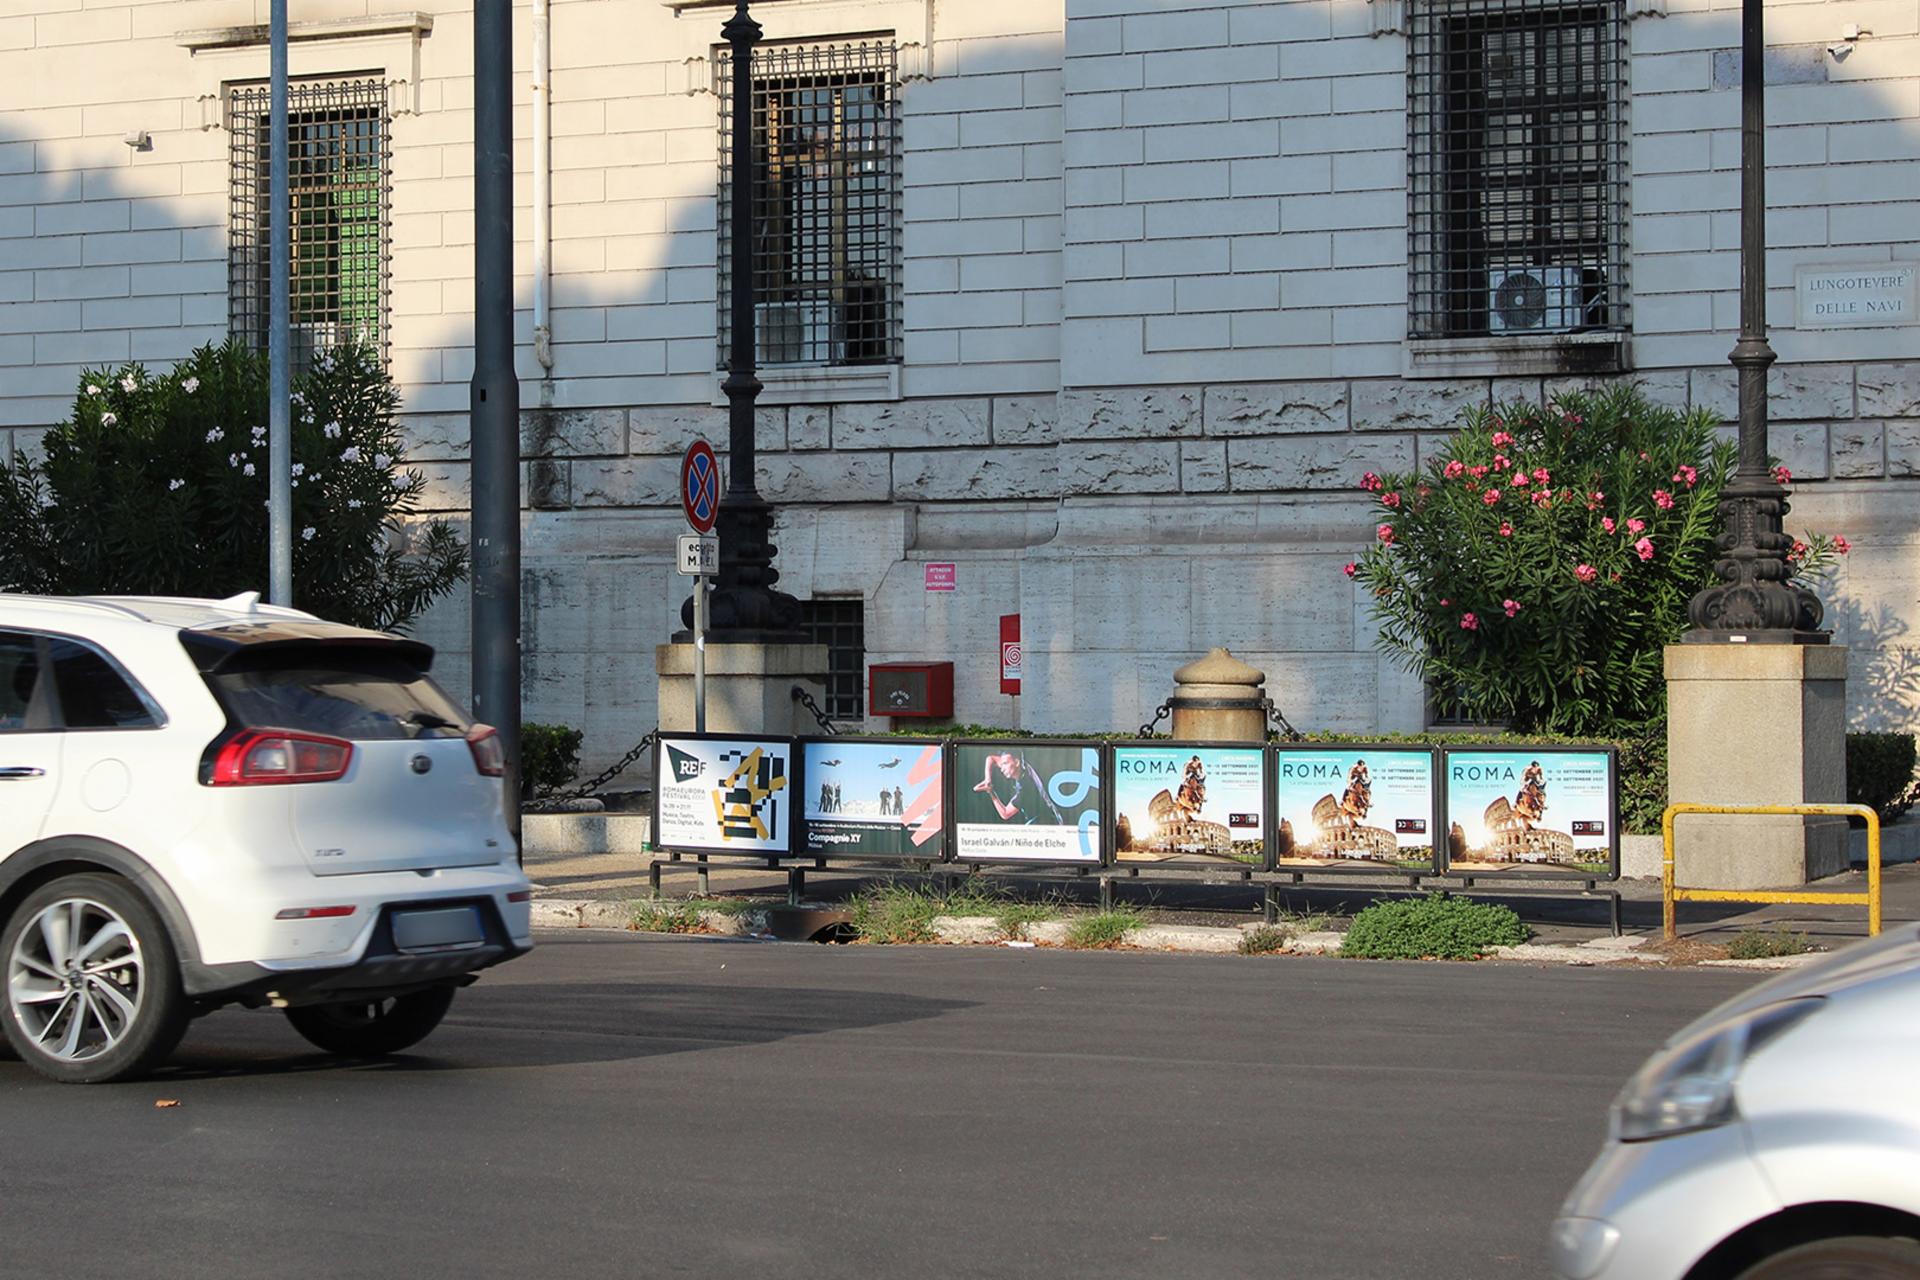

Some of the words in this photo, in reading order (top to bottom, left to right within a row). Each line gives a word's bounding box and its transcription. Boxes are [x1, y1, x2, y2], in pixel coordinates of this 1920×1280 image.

[1809, 276, 1904, 291] LUNGOTEVERE
[1815, 302, 1857, 315] DELLE
[1866, 300, 1902, 312] NAVI
[1120, 759, 1177, 774] ROMA
[1283, 763, 1342, 778] ROMA
[1453, 766, 1515, 781] ROMA
[808, 832, 850, 844] Compagnie
[850, 833, 861, 843] XY
[961, 837, 982, 846] Israel
[1034, 839, 1044, 848] de
[1044, 839, 1066, 849] Elche
